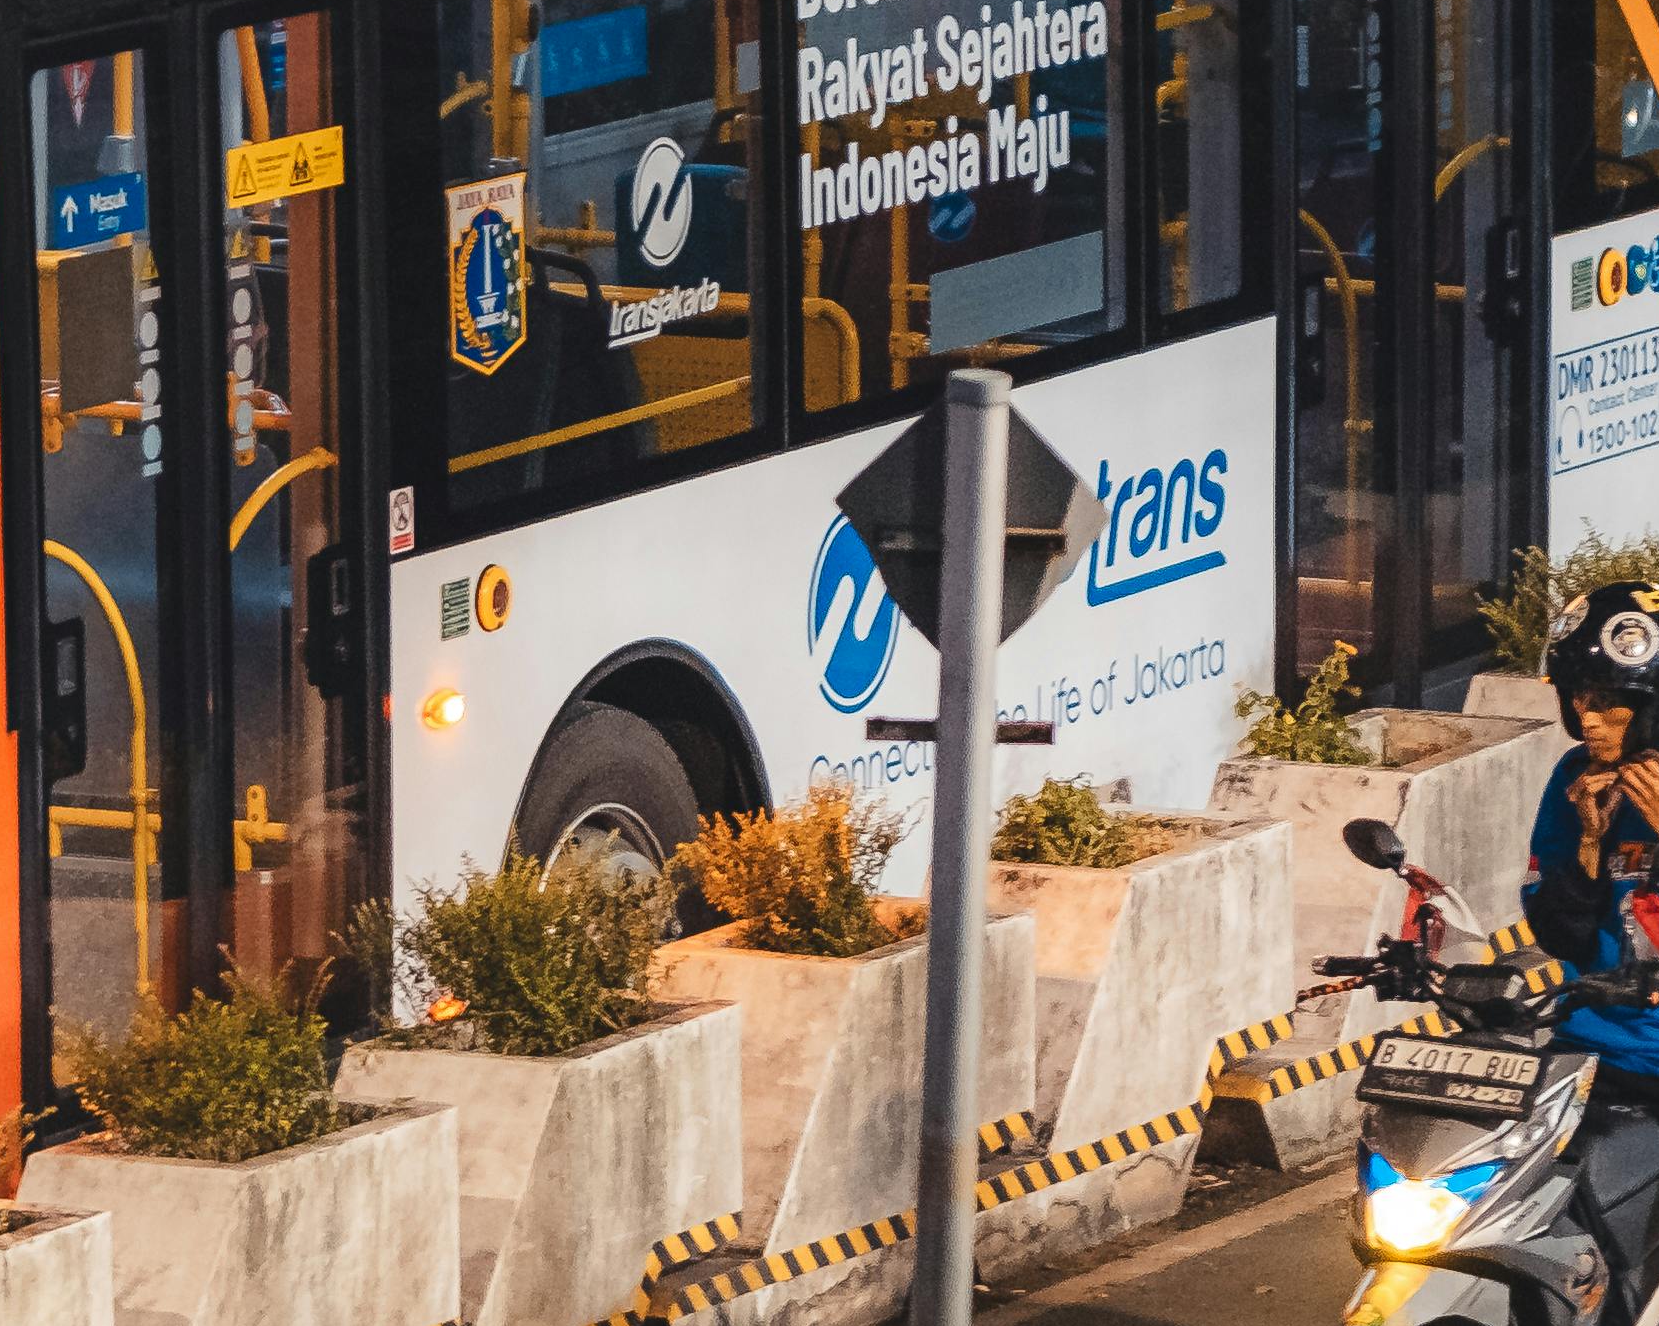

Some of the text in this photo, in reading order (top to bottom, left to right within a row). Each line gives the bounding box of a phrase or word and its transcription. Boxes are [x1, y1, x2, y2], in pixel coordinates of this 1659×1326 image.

[798, 0, 1108, 129] Rakyat Sejahtera
[799, 94, 1070, 229] Indonesia Maju
[1558, 336, 1659, 400] DMR 230113
[1589, 409, 1658, 454] 1500-102
[1091, 660, 1117, 714] of
[1124, 637, 1225, 704] Jakarta
[1407, 1046, 1473, 1073] 4017
